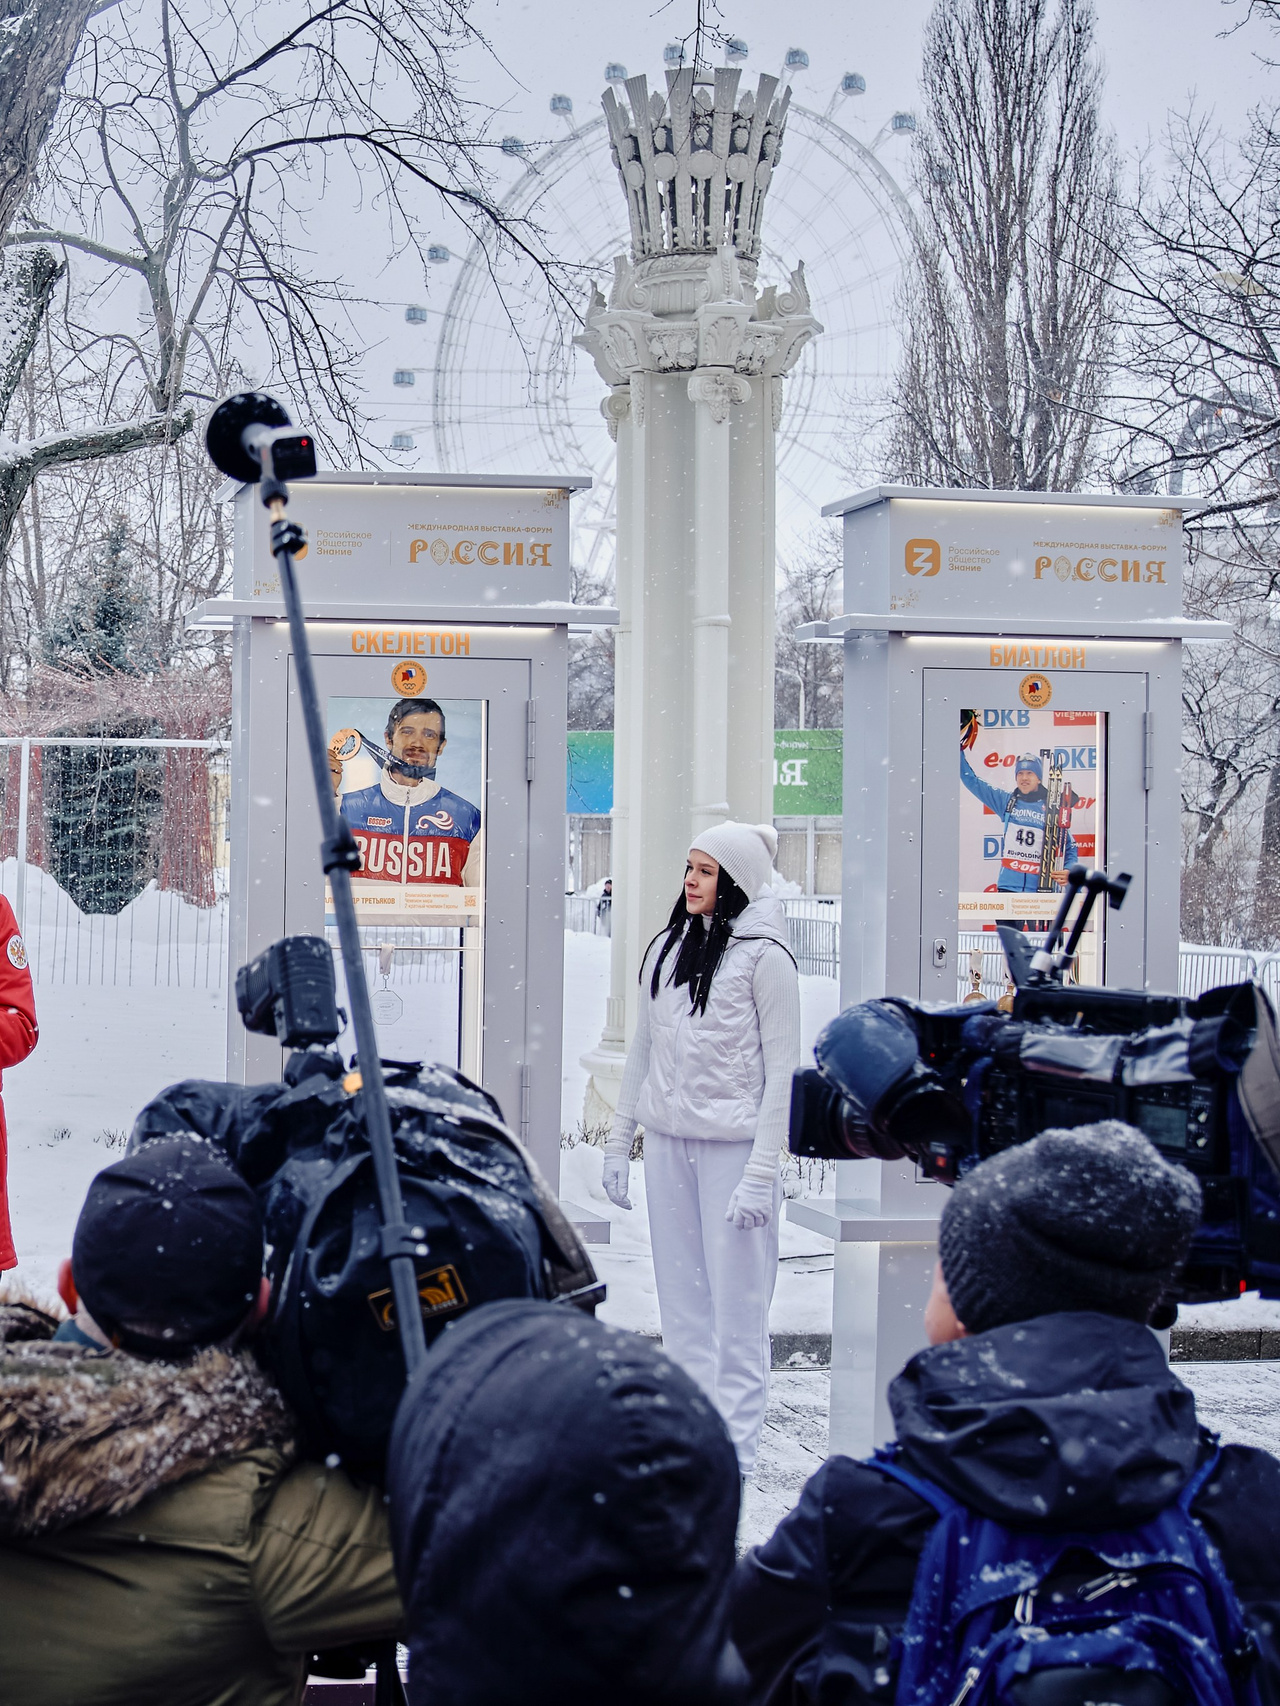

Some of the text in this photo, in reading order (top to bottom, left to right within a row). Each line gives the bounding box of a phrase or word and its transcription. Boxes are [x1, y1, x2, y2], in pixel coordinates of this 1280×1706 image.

[407, 523, 552, 534] МЕЖДУНАРОДНАЯ ВЫСТАВКА-ФОРУМ
[316, 530, 372, 539] Российское
[316, 539, 362, 548] общество
[1033, 541, 1167, 551] МЕЖДУНАРОДНАЯ ВЫСТАВКА-ФОРУМ
[316, 547, 352, 556] Знание
[408, 538, 552, 566] РОССИЯ
[948, 546, 1000, 556] Российское
[948, 555, 991, 564] общество
[948, 563, 982, 572] Знание
[1033, 555, 1167, 583] РОССИЯ
[351, 630, 470, 655] СКЕЛЕТОН
[989, 644, 1086, 669] БИАТЛОН
[983, 709, 1031, 727] DKB
[1016, 828, 1035, 847] 48
[361, 897, 396, 905] ТРЕТЬЯКОВ
[979, 903, 1005, 911] ВОЛКОВ
